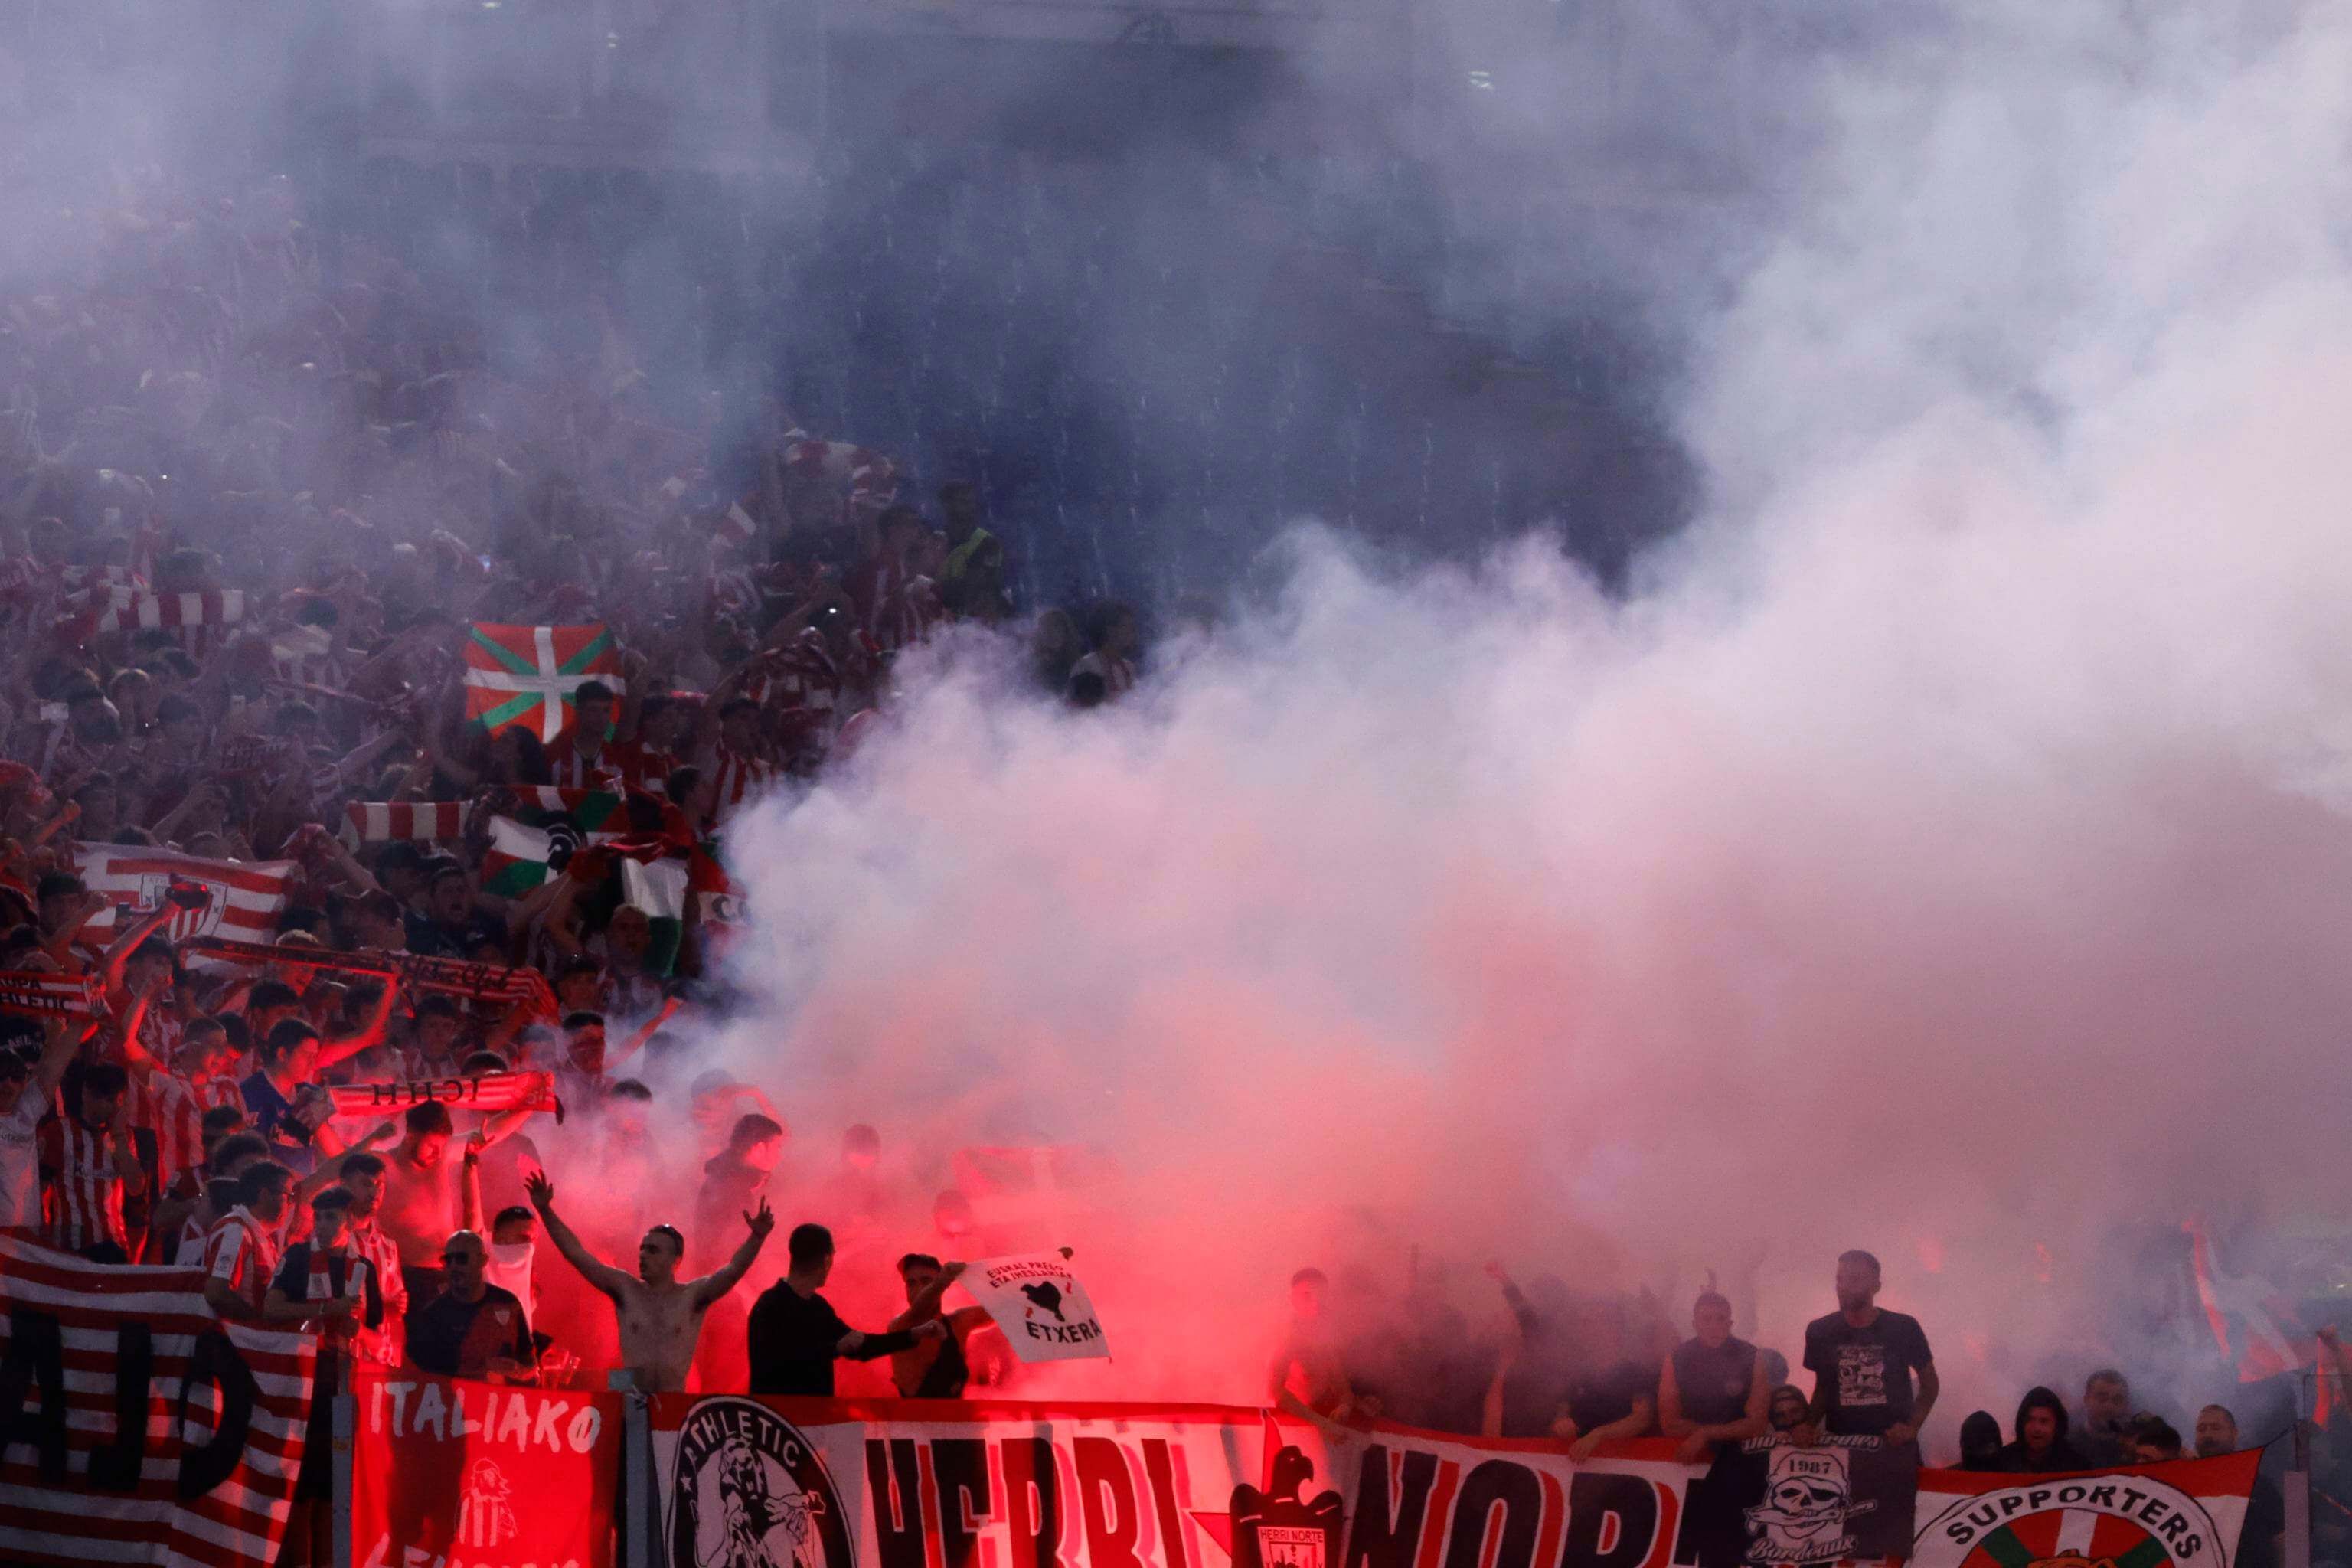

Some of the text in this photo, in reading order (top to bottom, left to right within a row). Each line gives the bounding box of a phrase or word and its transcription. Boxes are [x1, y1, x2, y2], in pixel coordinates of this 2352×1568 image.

[989, 1275, 1011, 1288] ETA
[1026, 1318, 1102, 1344] ETXERA
[371, 1381, 601, 1453] ITALIAKO
[1789, 1459, 1831, 1474] 1987
[865, 1439, 1713, 1568] HERRI NOR
[1947, 1485, 2202, 1559] SUPPORTERS
[1261, 1529, 1324, 1543] HERRI NORTE
[1747, 1535, 1857, 1561] Bordeaux
